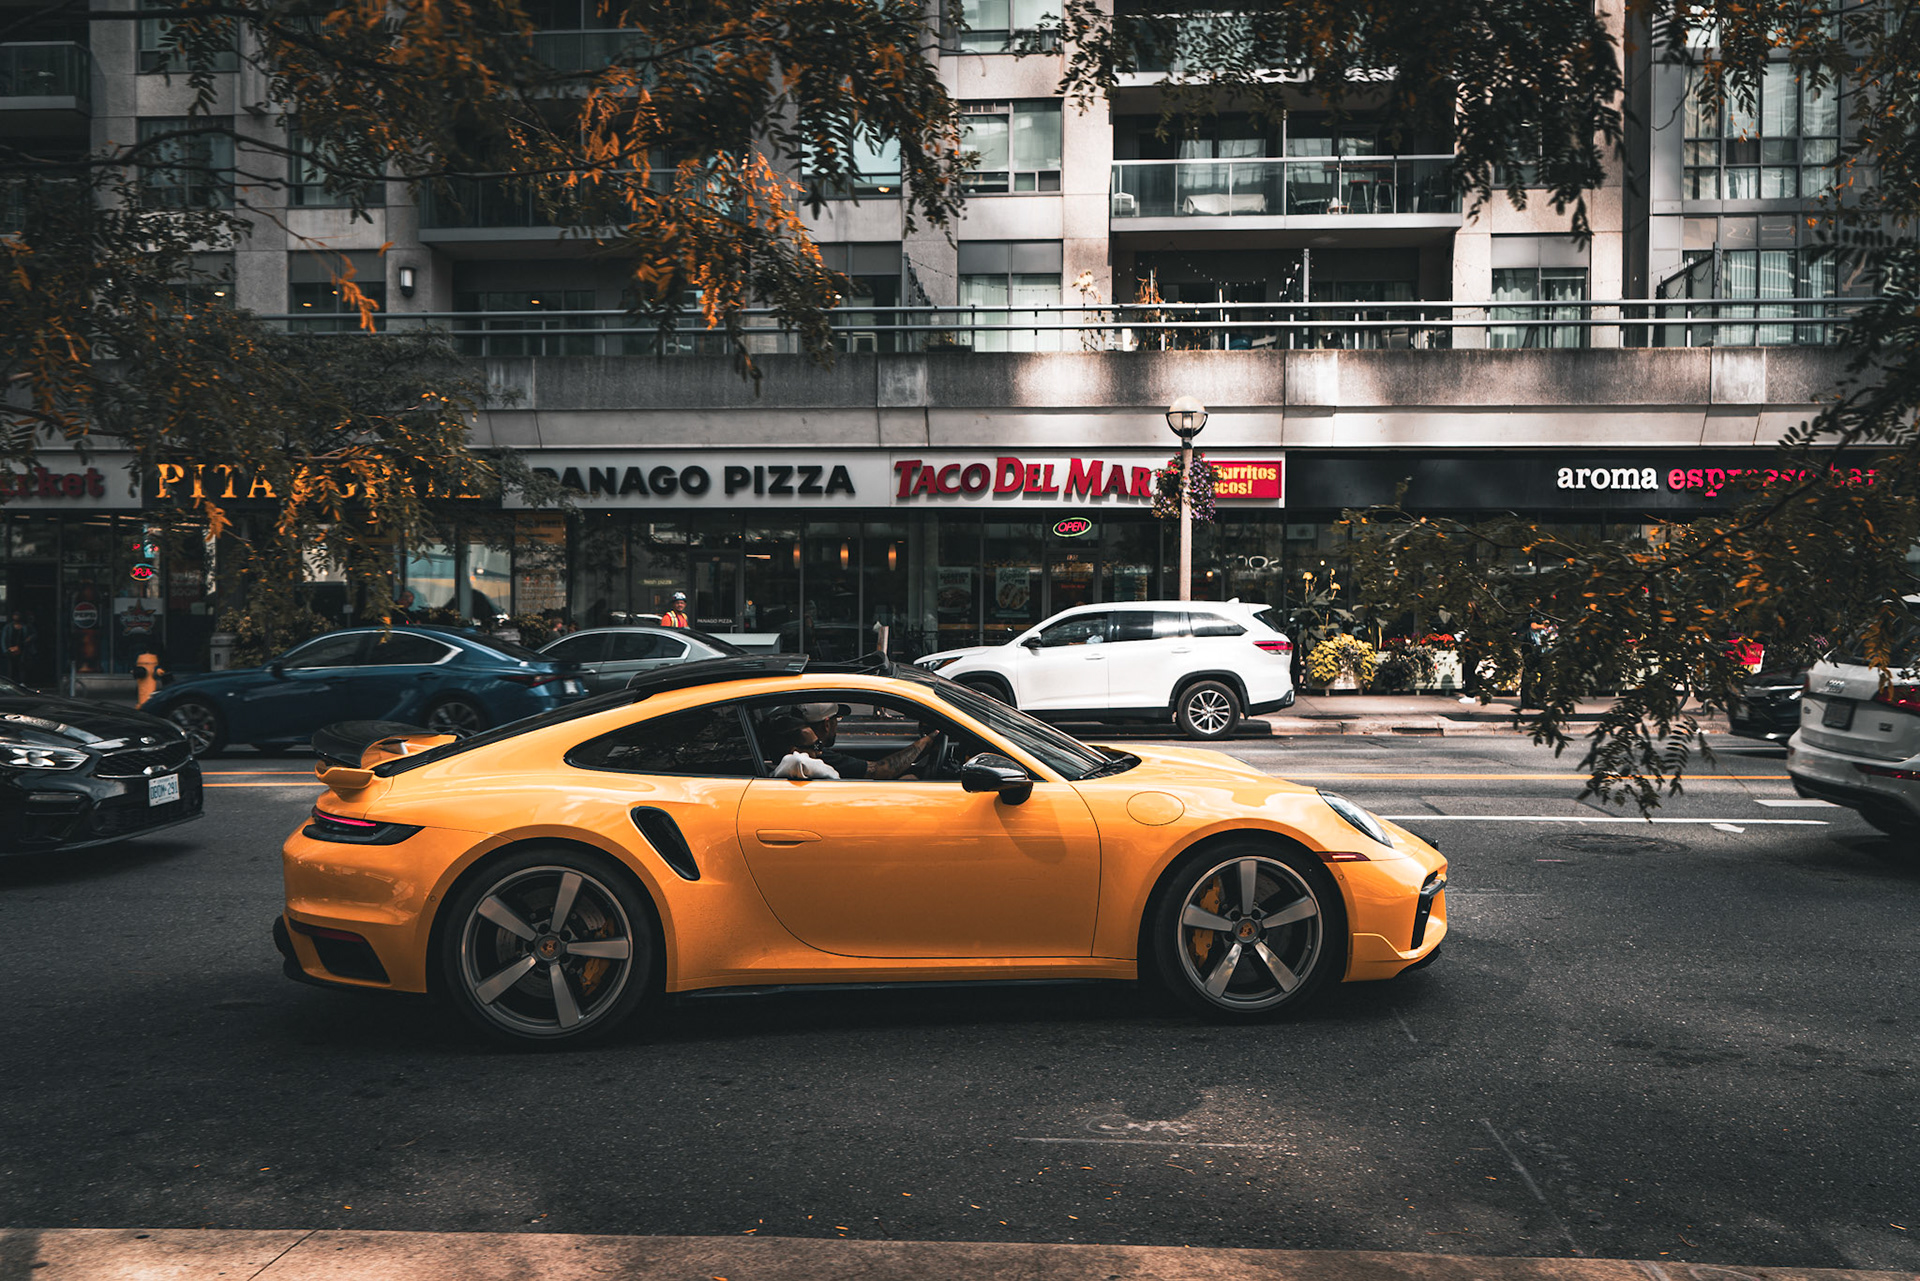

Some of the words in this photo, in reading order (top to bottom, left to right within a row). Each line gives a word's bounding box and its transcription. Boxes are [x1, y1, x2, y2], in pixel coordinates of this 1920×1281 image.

[0, 467, 105, 498] rket
[724, 465, 856, 495] PIZZA
[894, 460, 991, 498] TACO
[993, 457, 1059, 493] DEL
[1064, 458, 1152, 498] MAR
[1557, 467, 1658, 490] aroma
[1058, 521, 1087, 532] OPEN
